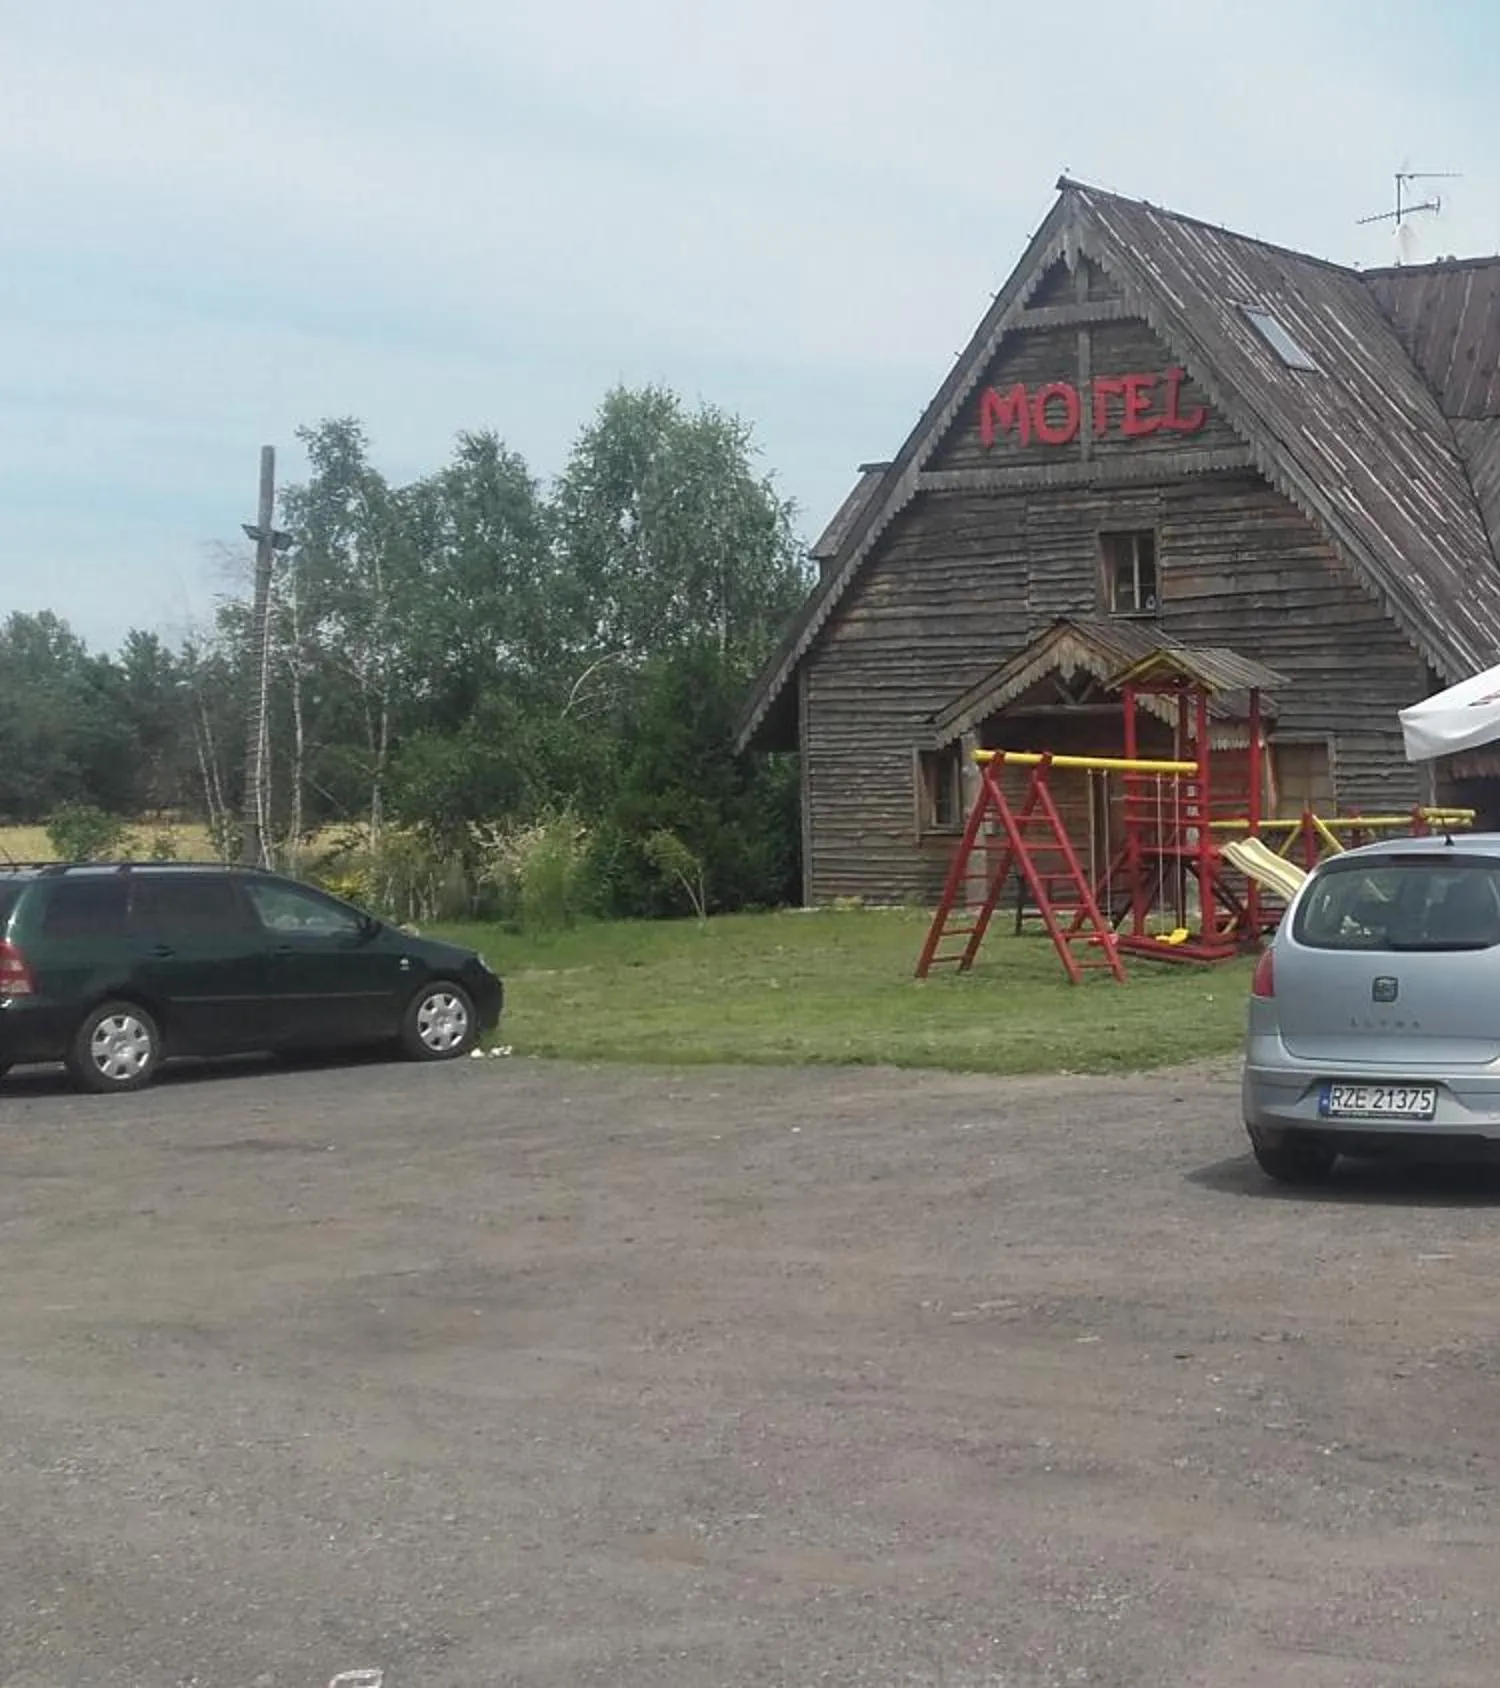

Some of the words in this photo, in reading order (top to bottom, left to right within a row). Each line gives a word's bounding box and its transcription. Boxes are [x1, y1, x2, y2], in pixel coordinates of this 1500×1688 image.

[979, 367, 1208, 447] MOTEL
[1332, 1087, 1369, 1108] RZE
[1372, 1088, 1433, 1110] 21375
